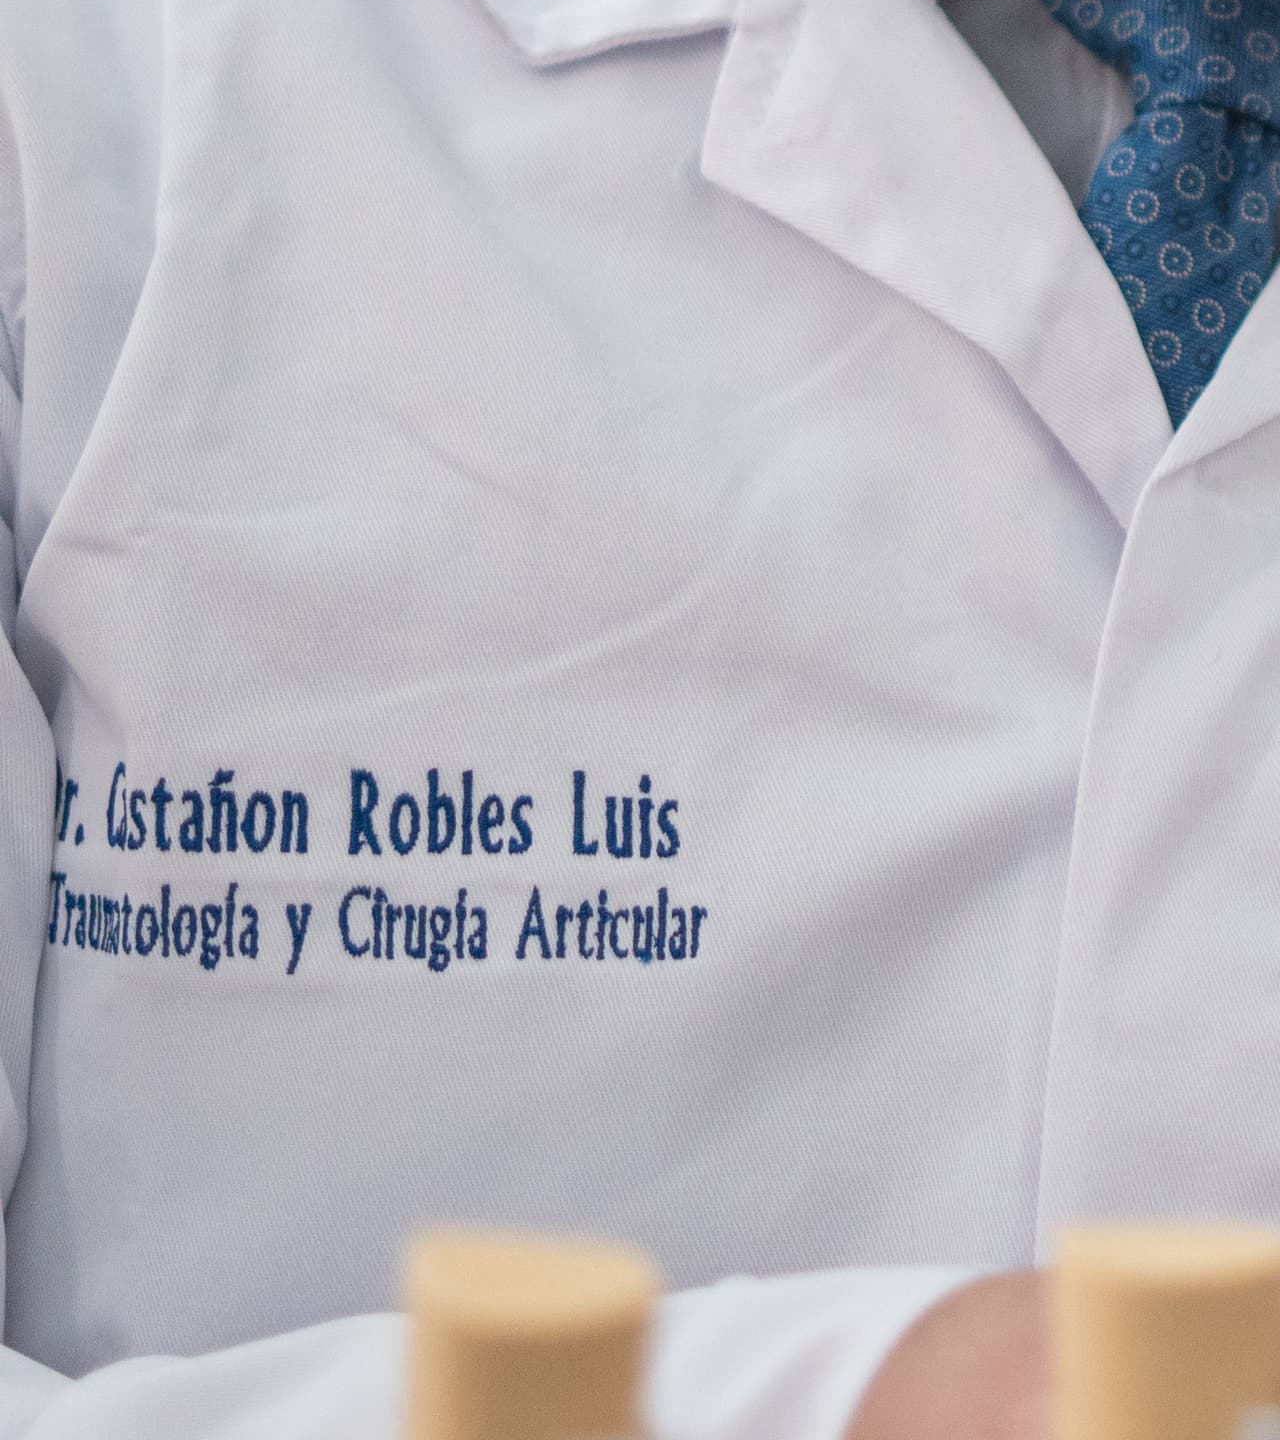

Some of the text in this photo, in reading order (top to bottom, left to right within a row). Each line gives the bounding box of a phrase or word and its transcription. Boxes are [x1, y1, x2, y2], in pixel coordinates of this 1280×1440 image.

[347, 767, 533, 856] Robles
[572, 770, 681, 858] Luis
[285, 903, 313, 974] y
[515, 885, 708, 962] Articular
